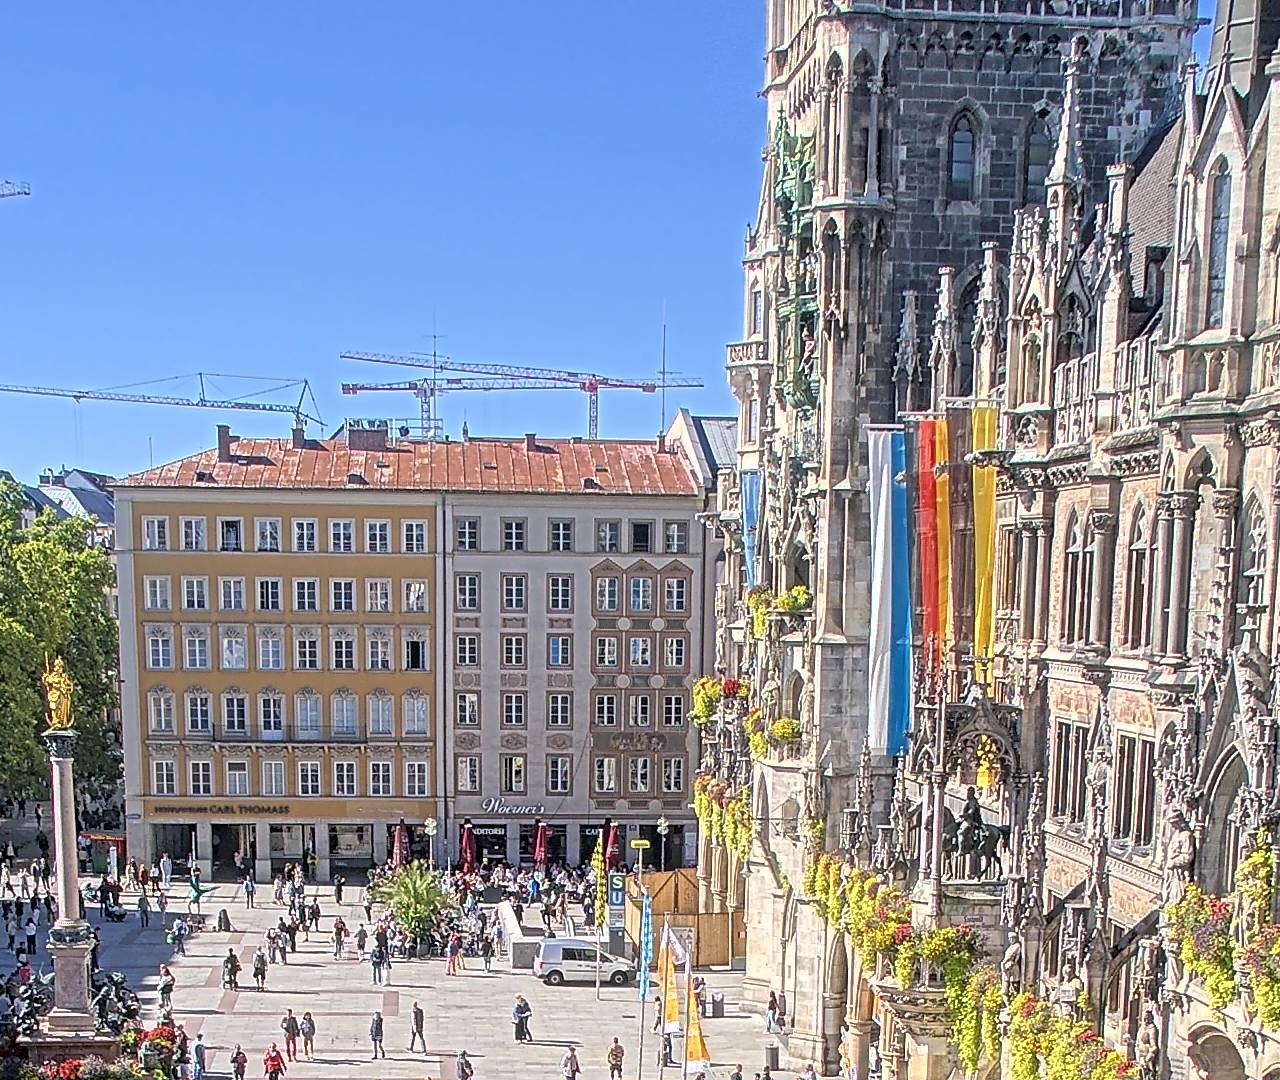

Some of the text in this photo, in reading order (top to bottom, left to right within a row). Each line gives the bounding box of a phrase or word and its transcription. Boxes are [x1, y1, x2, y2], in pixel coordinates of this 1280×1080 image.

[209, 805, 236, 814] CARL
[238, 805, 290, 814] THOMASS
[612, 876, 623, 889] S
[612, 892, 623, 904] U
